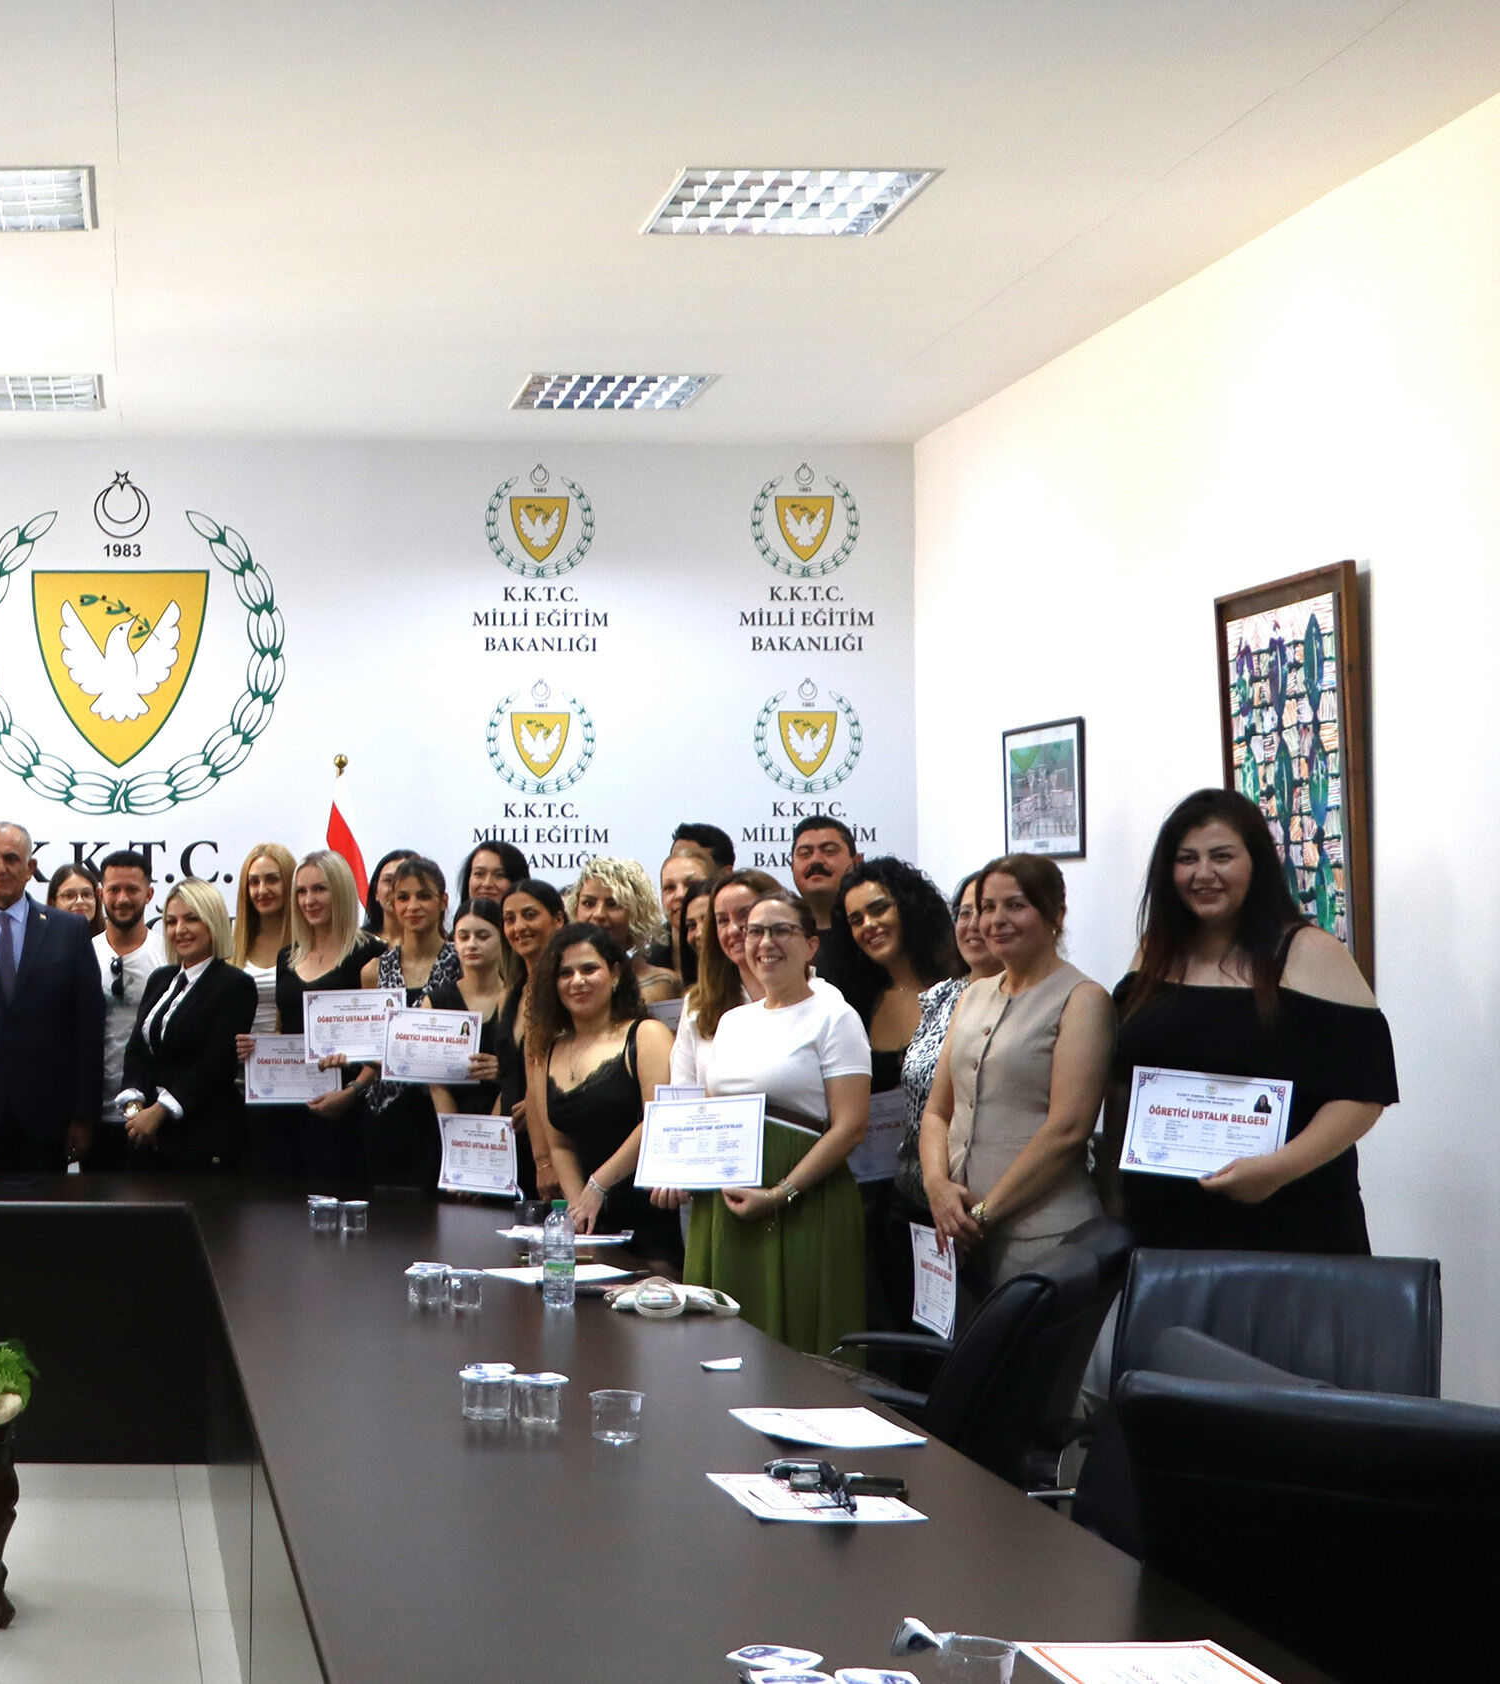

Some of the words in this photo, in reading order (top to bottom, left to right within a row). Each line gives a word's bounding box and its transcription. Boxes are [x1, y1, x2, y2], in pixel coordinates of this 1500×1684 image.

[103, 543, 142, 558] 1983
[503, 586, 579, 602] K.K.T.C.
[769, 585, 844, 601] K.K.T.C.
[472, 609, 528, 627] MİLLİ
[534, 608, 609, 627] EĞİTİM
[738, 608, 794, 626] MİLLİ
[801, 608, 875, 626] EĞİTİM
[484, 634, 597, 652] BAKANLIĞI
[750, 633, 864, 651] BAKANLIĞI
[503, 802, 579, 818] K.K.T.C.
[771, 801, 847, 817] K.K.T.C.
[473, 825, 529, 843] MİLLİ
[535, 825, 609, 843] EĞİTİM
[528, 851, 598, 869] ANLIĞ
[371, 1014, 386, 1022] BELG
[1149, 1104, 1190, 1119] ÖĞRETİCİ
[1192, 1110, 1229, 1122] USTALIK
[1231, 1113, 1269, 1126] BELGESİ
